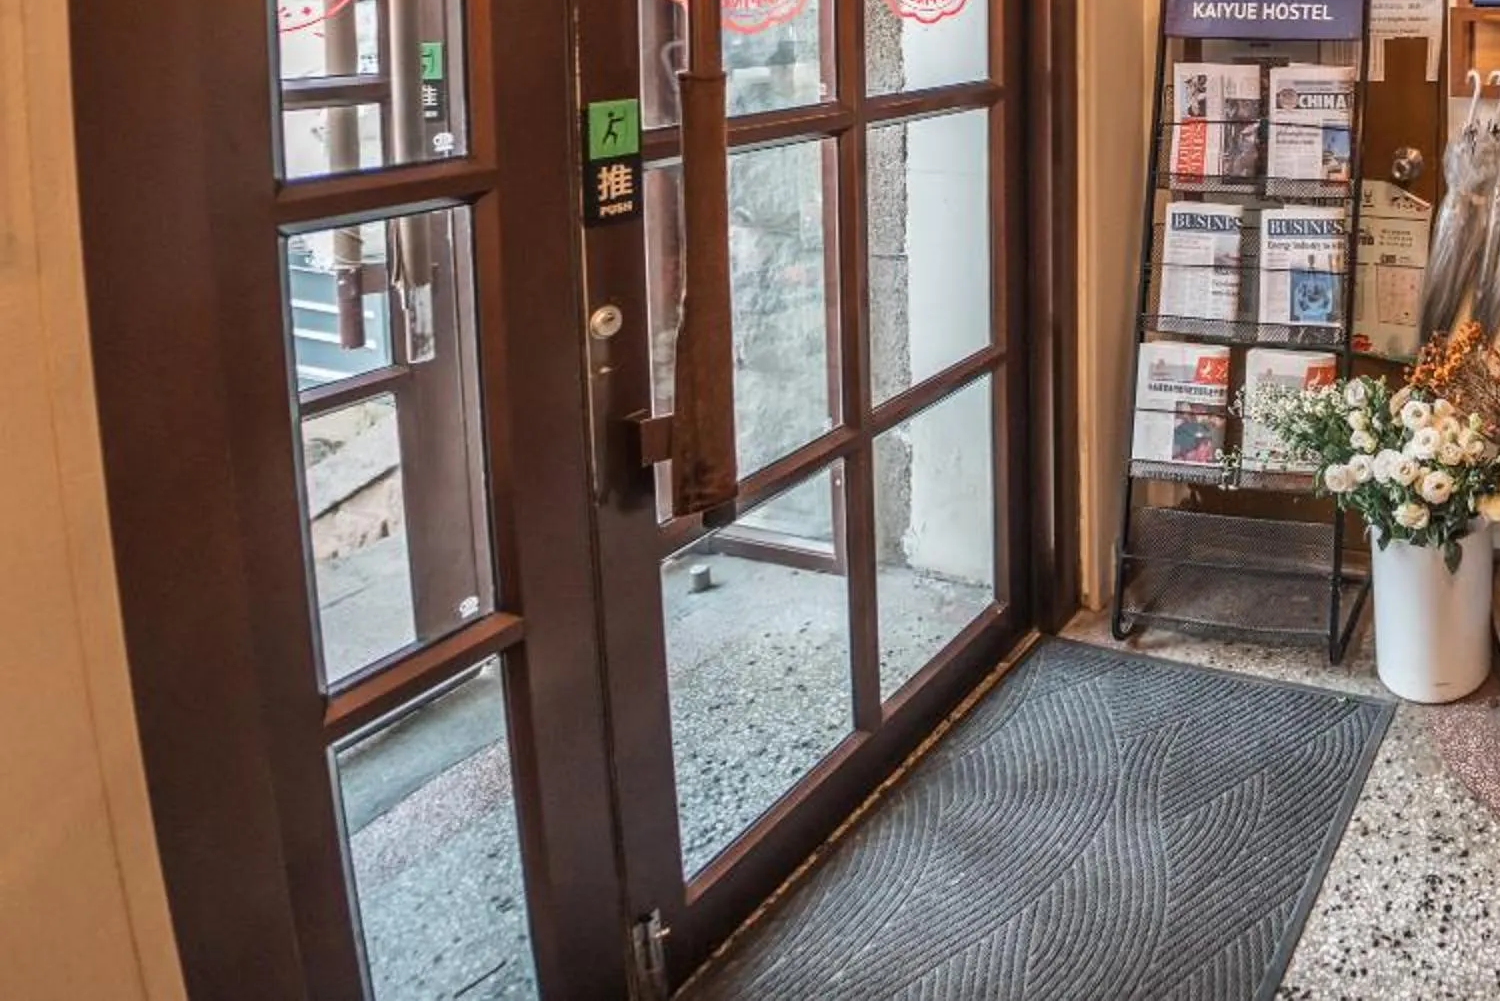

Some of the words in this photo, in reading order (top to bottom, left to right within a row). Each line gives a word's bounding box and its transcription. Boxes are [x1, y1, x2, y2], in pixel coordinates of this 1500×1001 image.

[1192, 1, 1257, 21] KAIYUE
[1262, 3, 1333, 21] HOSTEL
[1299, 92, 1347, 110] CHINA
[597, 164, 632, 200] 推
[600, 200, 632, 216] PUSH
